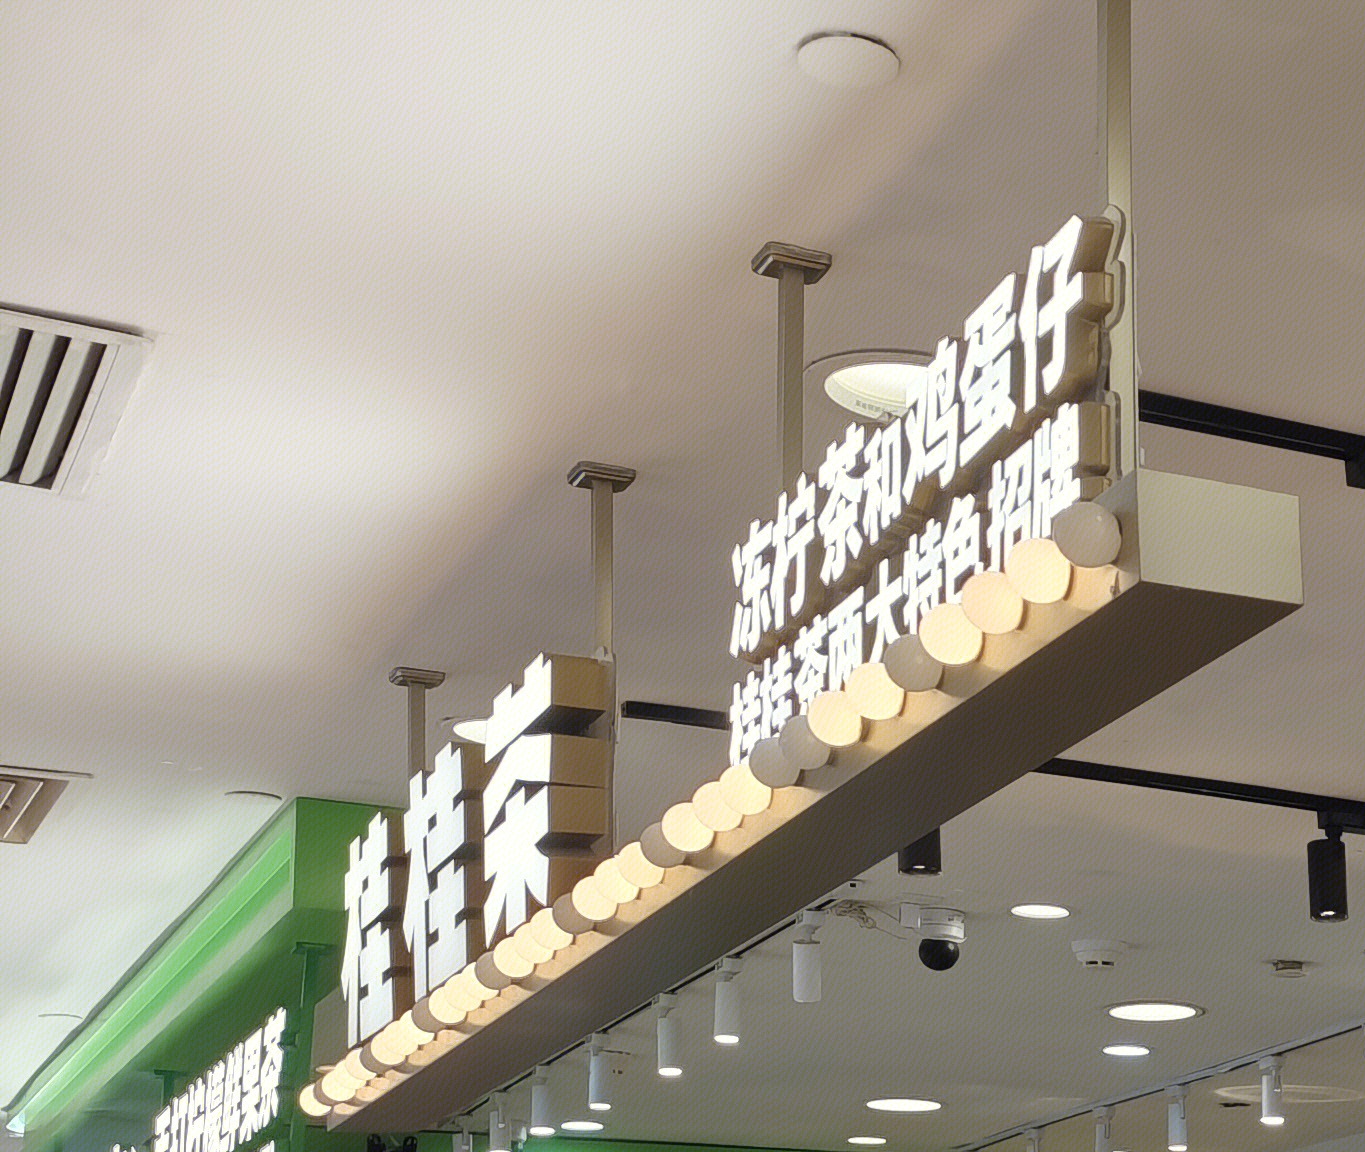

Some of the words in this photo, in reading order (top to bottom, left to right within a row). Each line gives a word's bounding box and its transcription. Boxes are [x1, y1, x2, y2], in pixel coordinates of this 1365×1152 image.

[729, 403, 1080, 766] 桂桂茶两大特色招牌
[730, 213, 1085, 658] 冻柠茶和鸡蛋仔
[340, 653, 552, 1044] 桂桂茶
